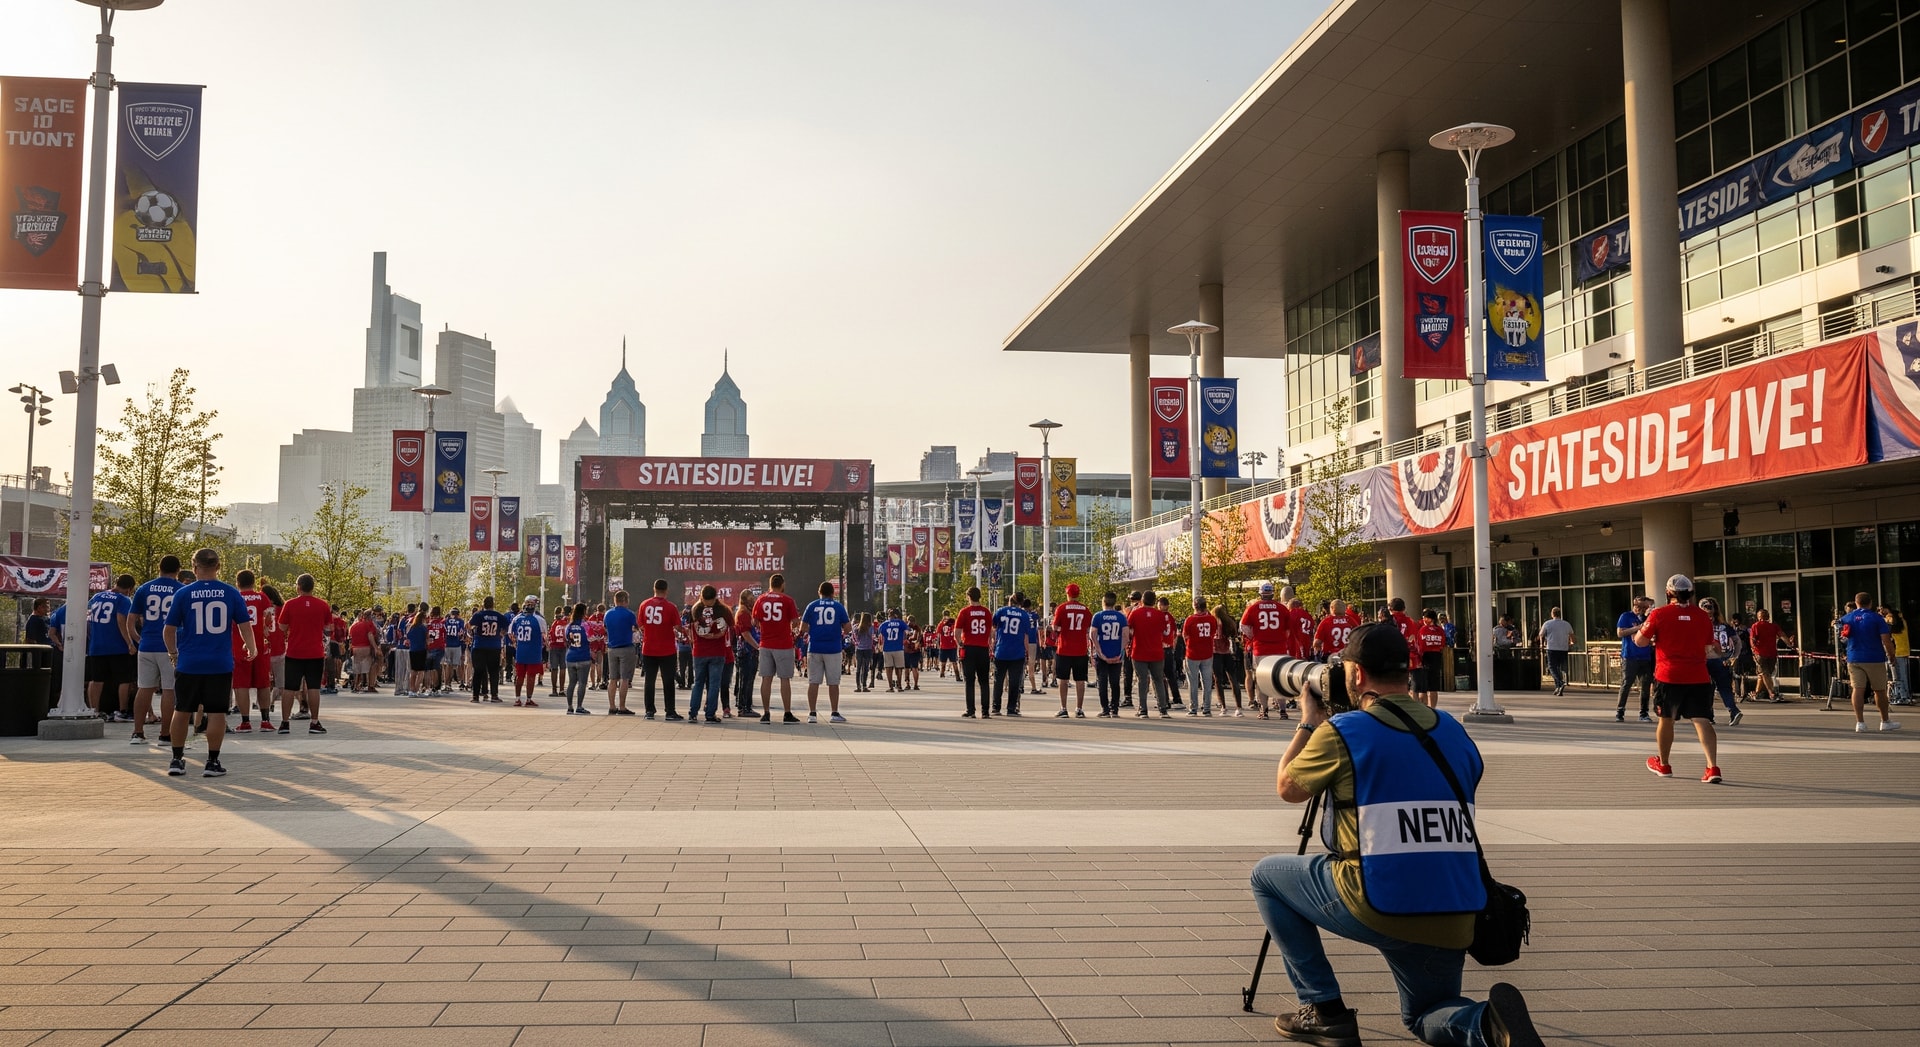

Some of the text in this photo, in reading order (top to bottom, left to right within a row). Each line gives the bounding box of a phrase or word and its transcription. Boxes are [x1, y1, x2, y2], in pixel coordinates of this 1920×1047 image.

[1508, 368, 1826, 501] STATESIDE LIVE!
[639, 462, 814, 487] STATESIDE LIVE!
[191, 601, 227, 634] 10
[645, 606, 663, 625] 95
[762, 602, 783, 621] 95
[1397, 807, 1475, 843] NEWS
